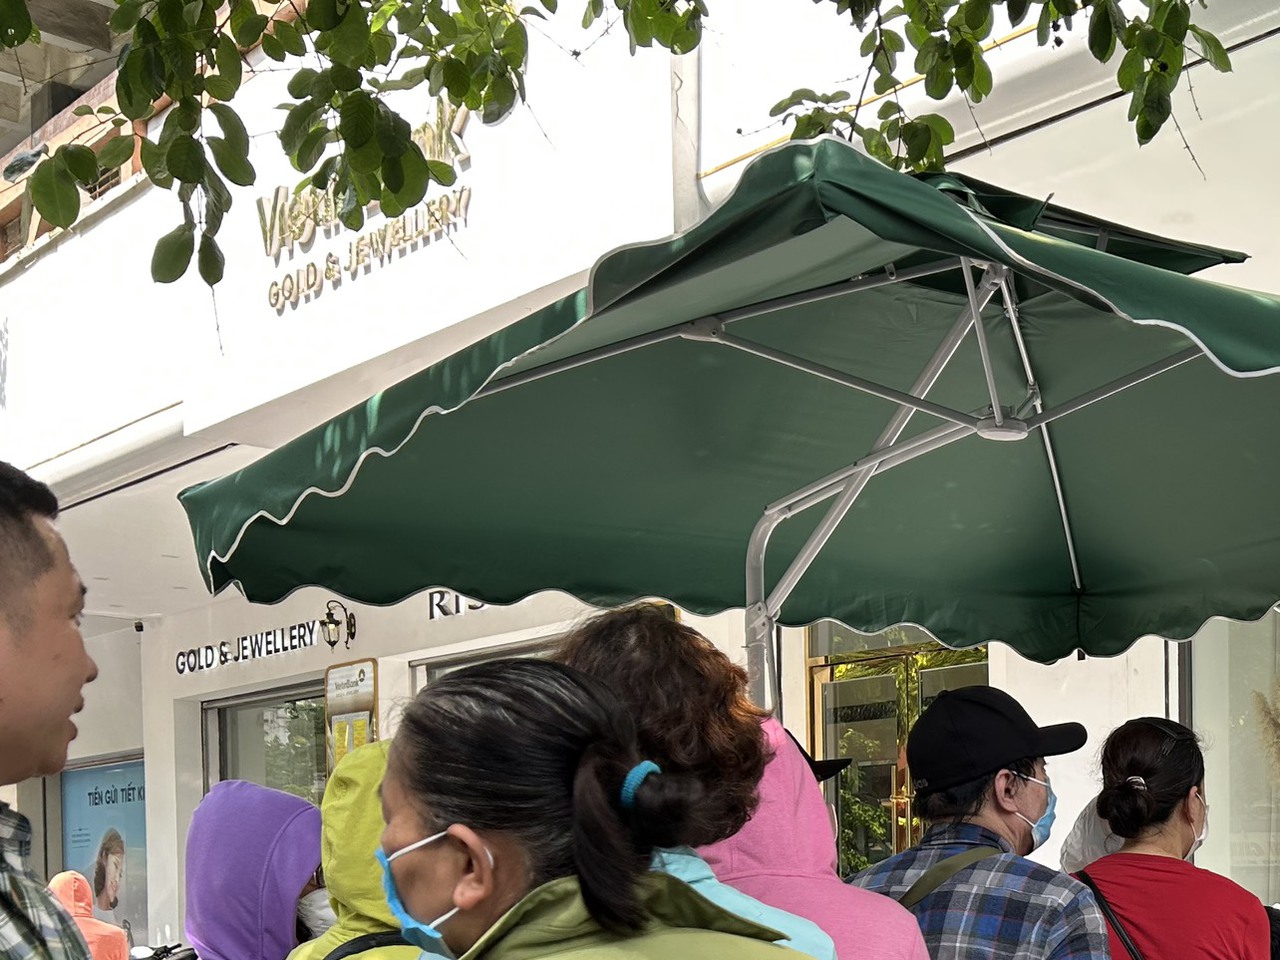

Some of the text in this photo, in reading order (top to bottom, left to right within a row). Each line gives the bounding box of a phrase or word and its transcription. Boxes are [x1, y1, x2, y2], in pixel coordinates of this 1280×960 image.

[268, 262, 323, 311] GOLD
[176, 620, 317, 674] GOLD & JEWELLERY
